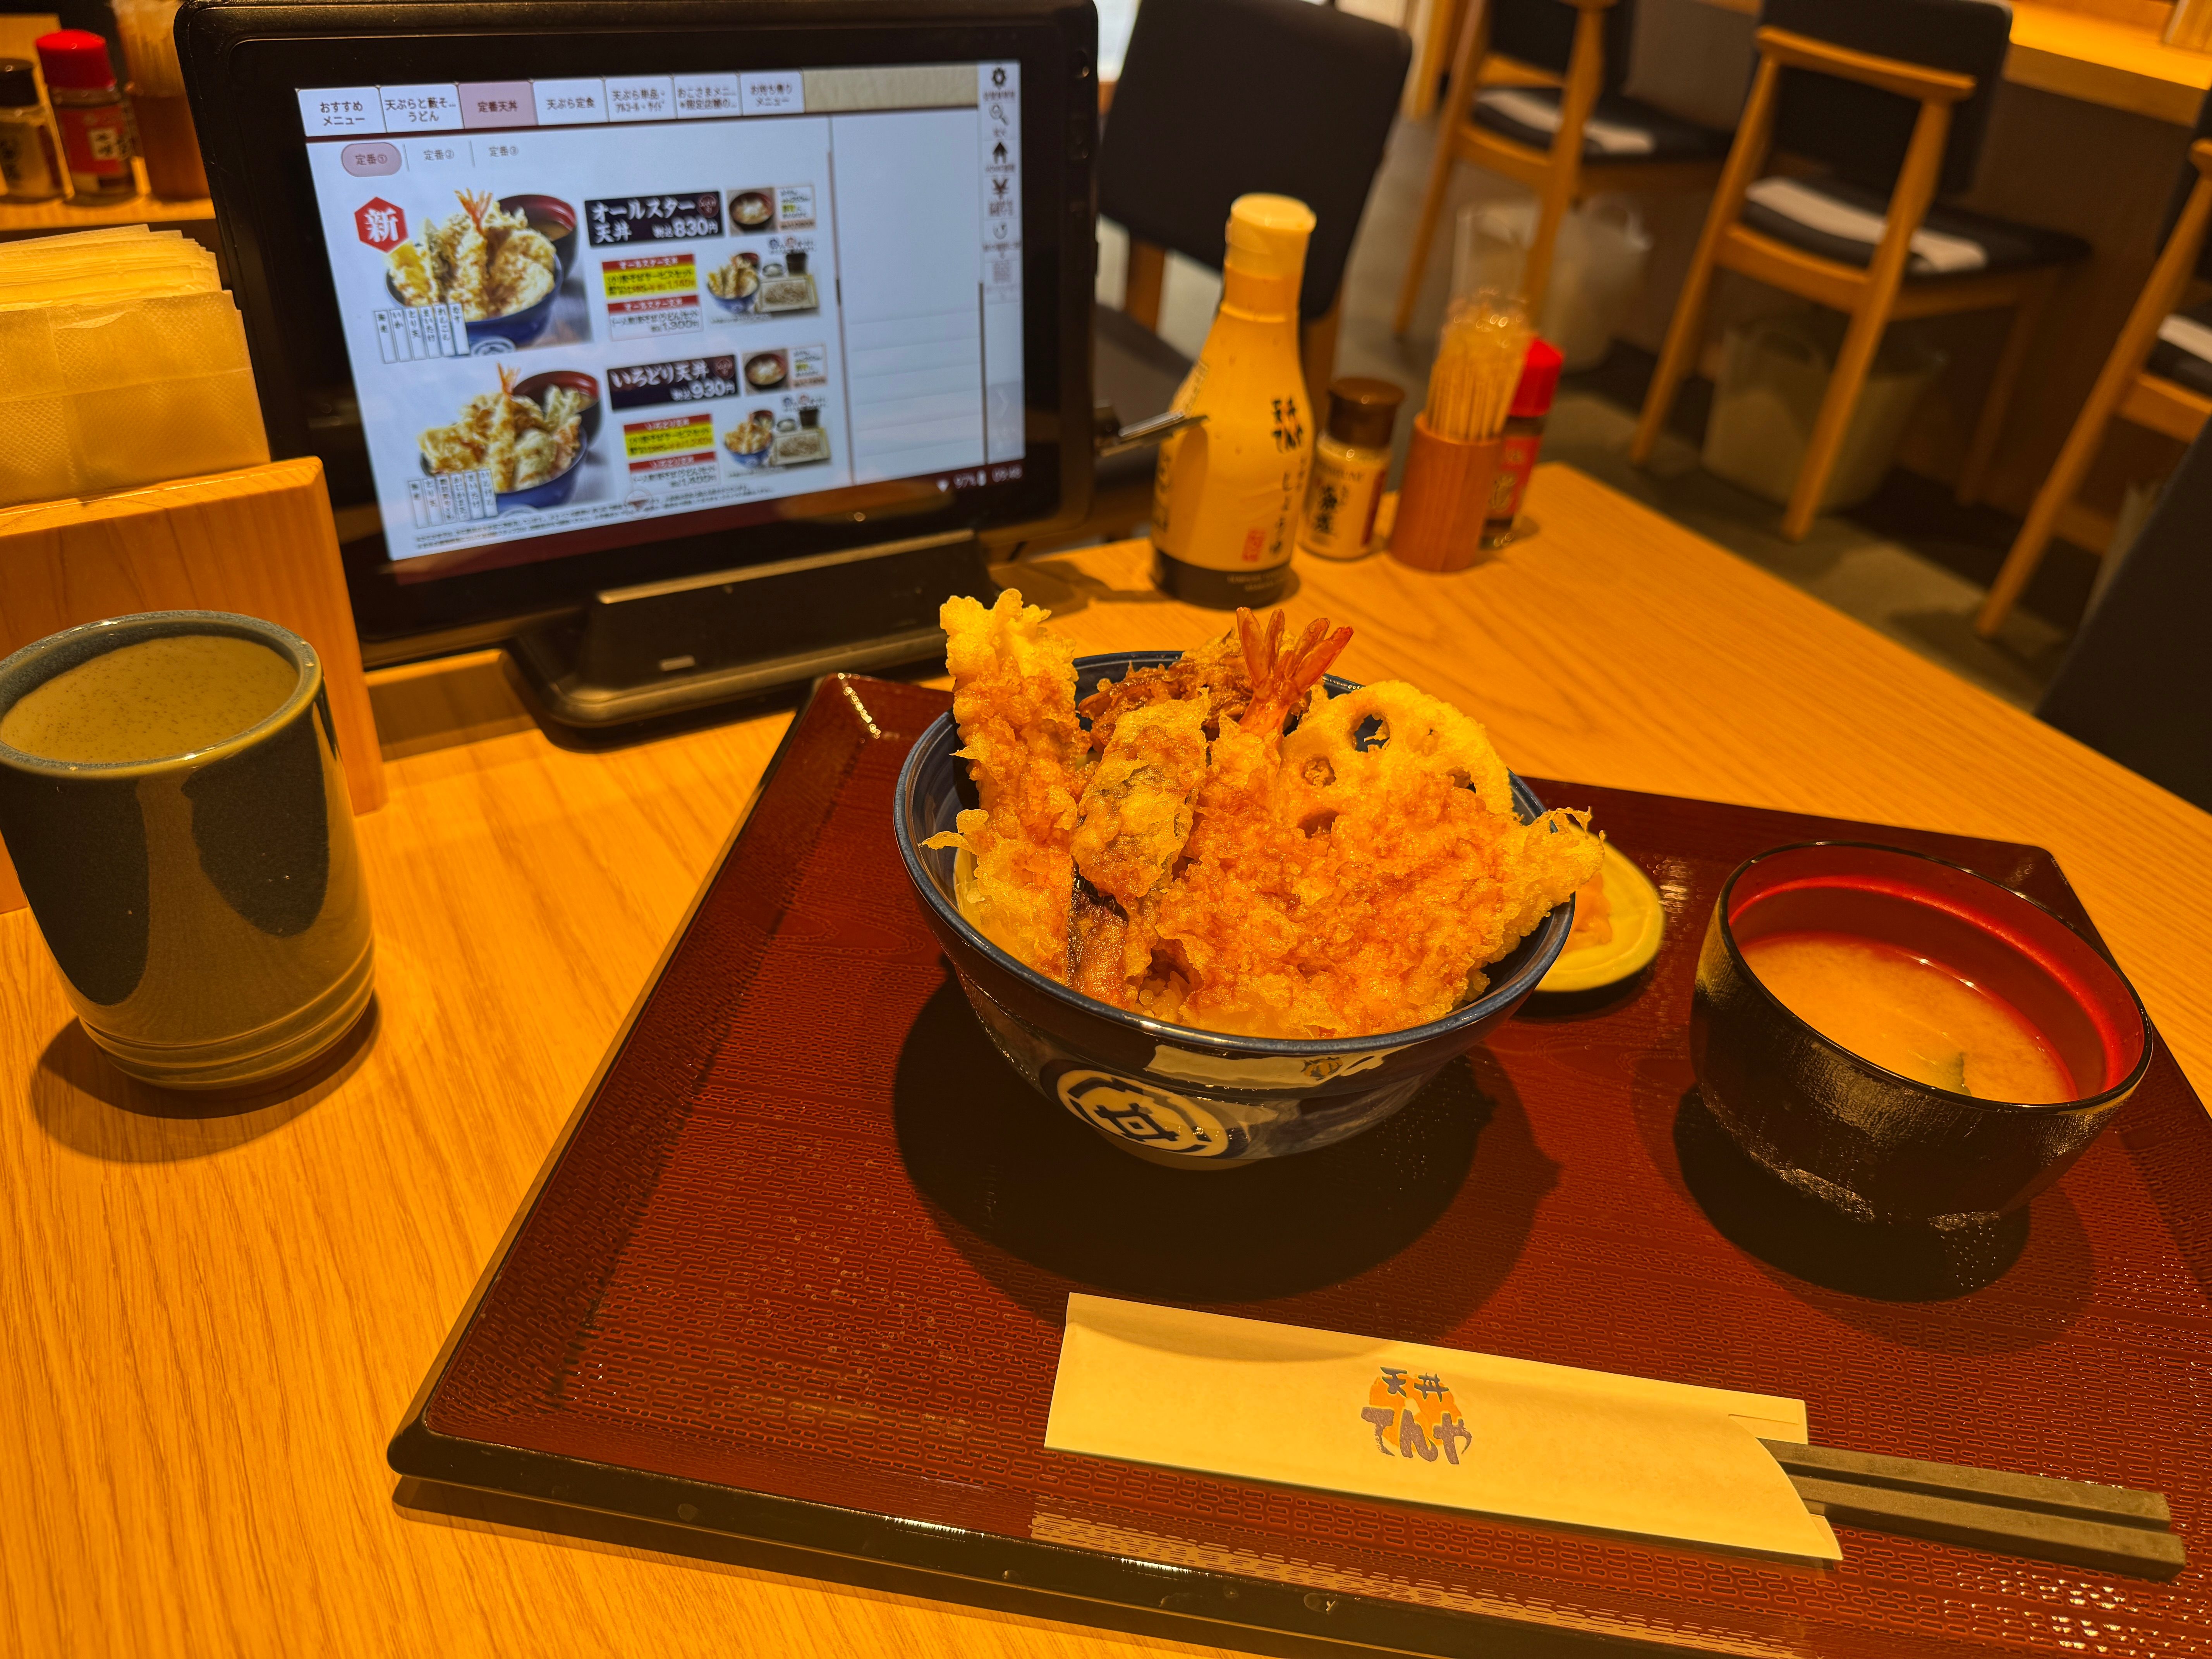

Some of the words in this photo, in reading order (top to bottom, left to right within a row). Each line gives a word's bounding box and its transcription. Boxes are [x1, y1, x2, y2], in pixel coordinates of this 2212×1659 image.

[319, 101, 363, 113] おすすめ
[477, 100, 518, 113] 定番天丼
[546, 97, 595, 110] 天ぷら定食
[757, 97, 790, 107] メニュー
[323, 116, 365, 126] メニュー
[409, 111, 439, 123] うどん
[423, 149, 455, 161] 定番②
[489, 145, 519, 158] 定番③
[355, 154, 388, 166] 定番①
[591, 196, 696, 223] オールスター
[365, 207, 399, 243] 新
[594, 219, 632, 243] 天丼
[610, 359, 709, 388] いろどり天丼
[1380, 1366, 1449, 1403] 天丼
[1361, 1406, 1472, 1465] てんや
